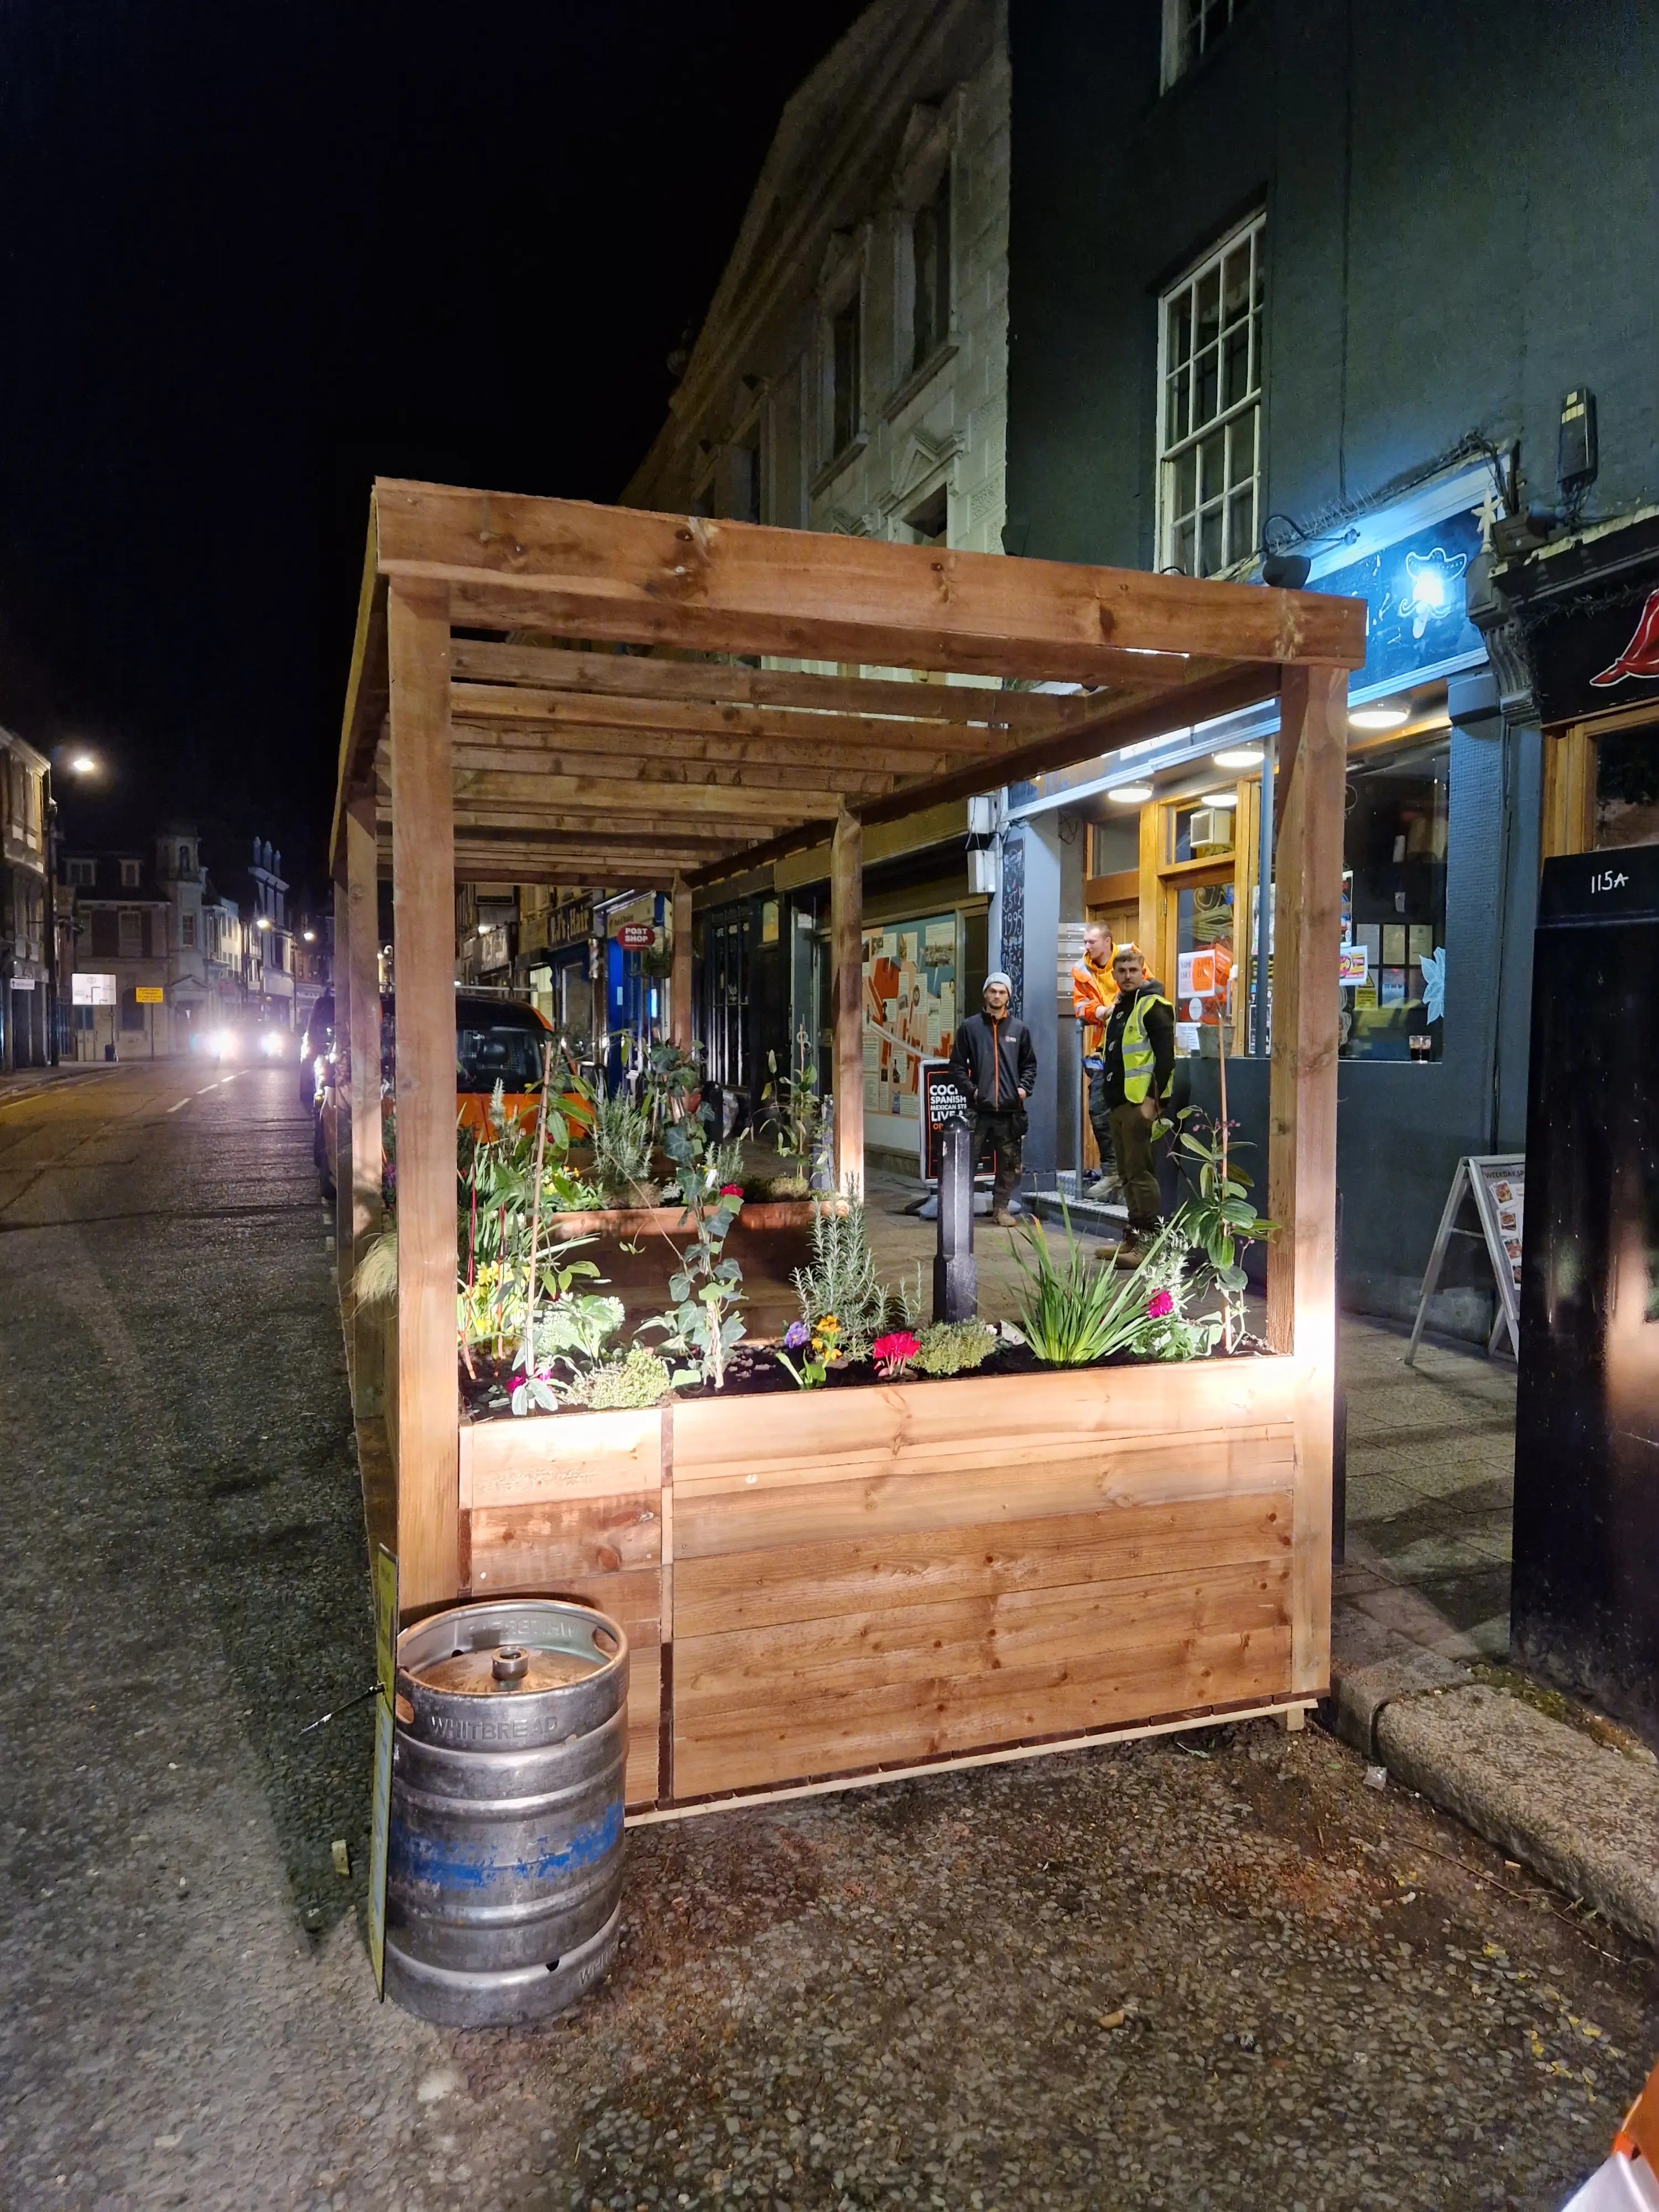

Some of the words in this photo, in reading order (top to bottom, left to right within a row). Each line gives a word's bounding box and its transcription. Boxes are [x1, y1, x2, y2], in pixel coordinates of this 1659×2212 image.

[1592, 870, 1629, 894] 115A
[1004, 907, 1023, 936] 1995
[930, 1095, 967, 1104] SPANISH
[1484, 1170, 1515, 1179] WEEKDAY
[430, 1715, 558, 1740] WHITBREAD
